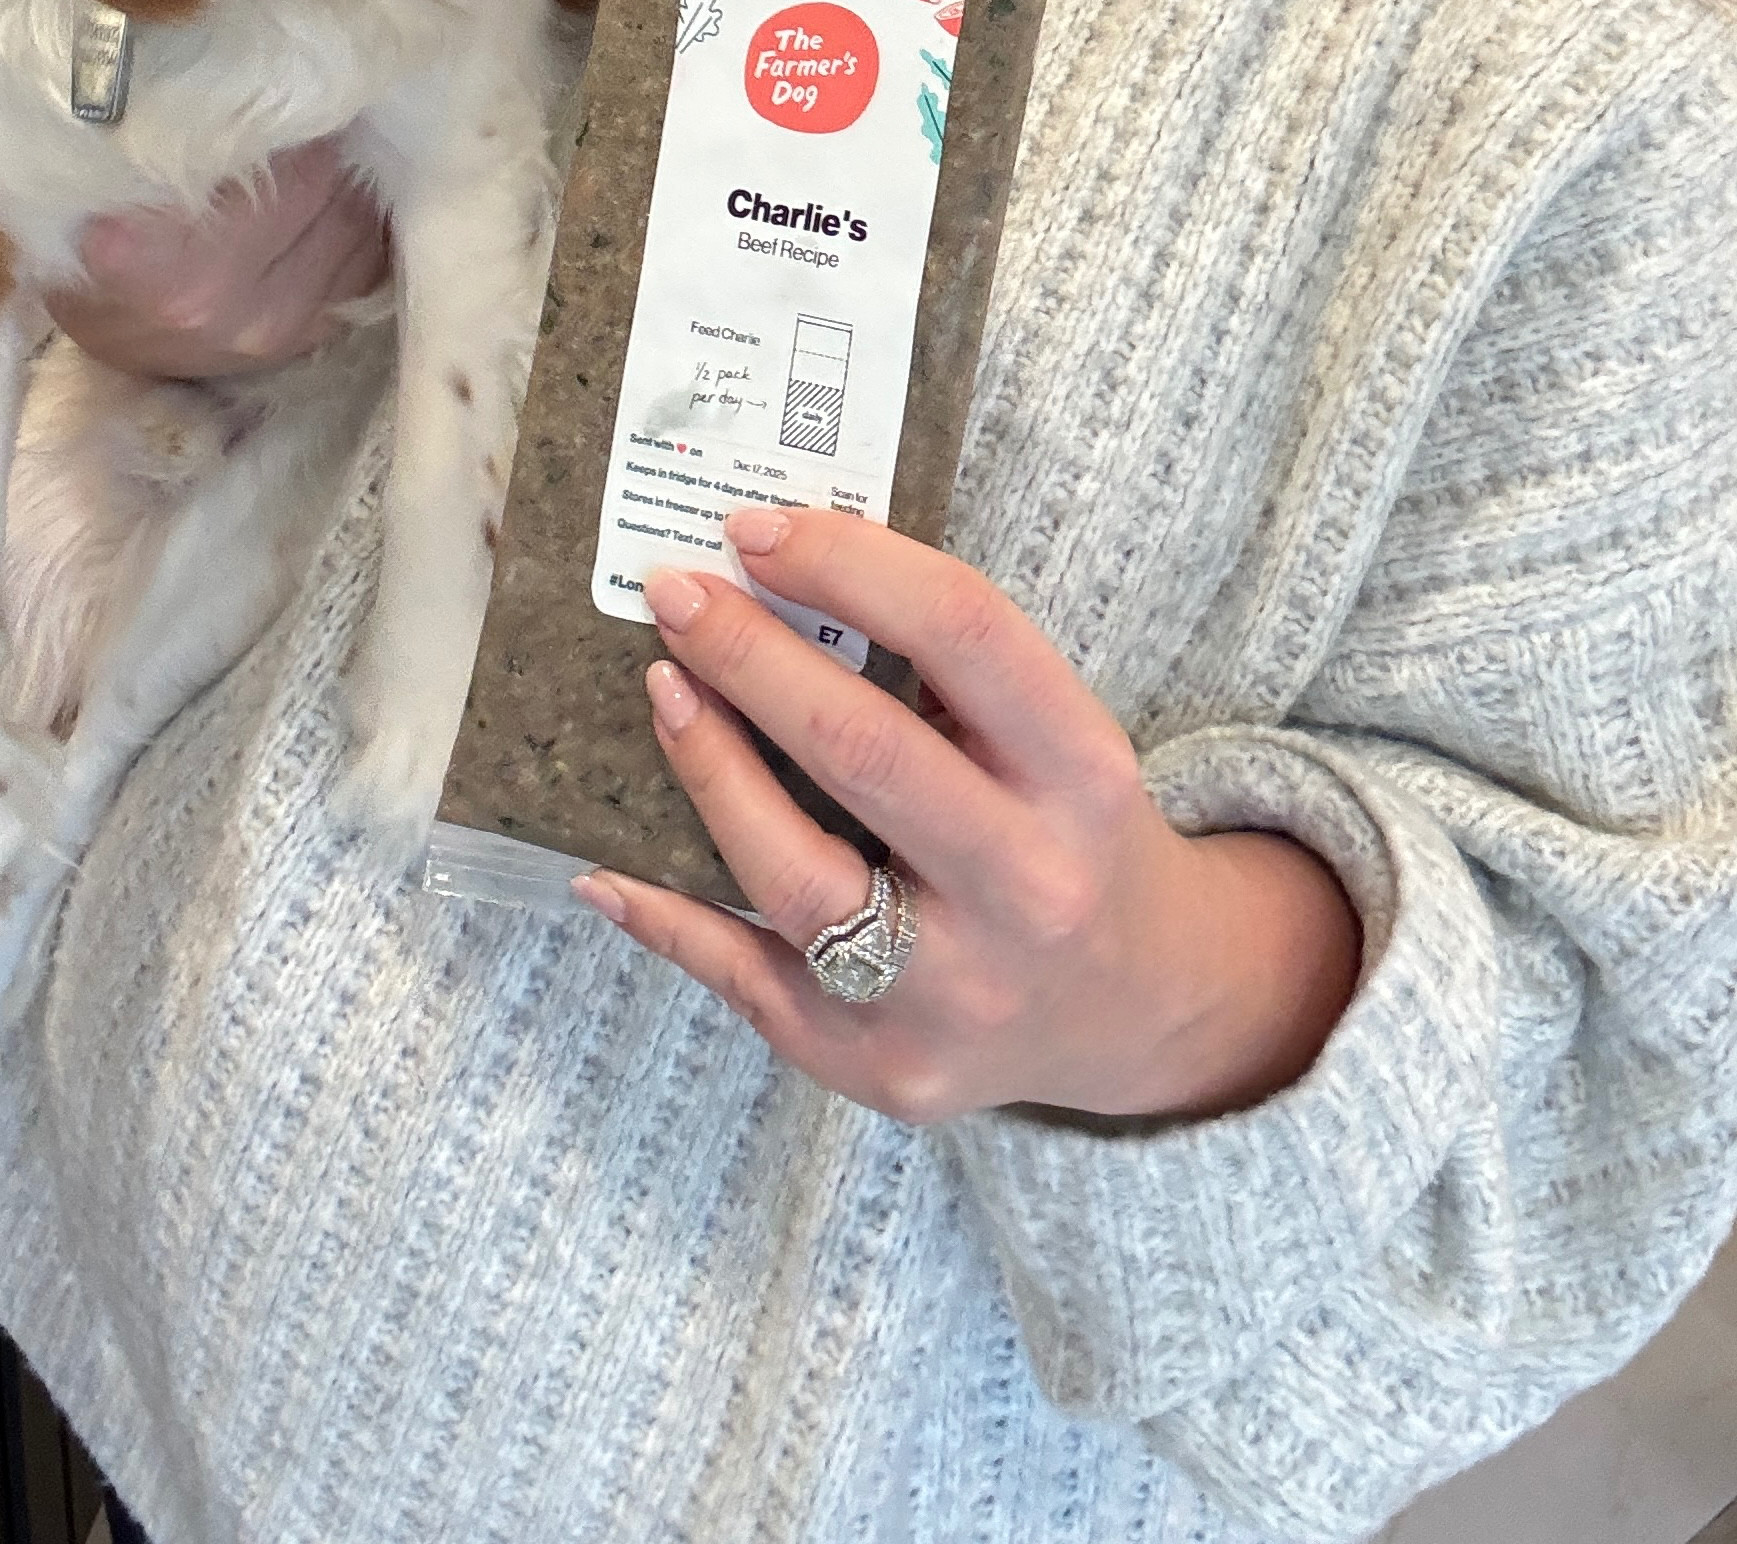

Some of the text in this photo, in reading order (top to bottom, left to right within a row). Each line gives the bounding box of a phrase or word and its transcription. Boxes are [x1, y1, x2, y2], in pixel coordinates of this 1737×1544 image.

[774, 27, 824, 51] The
[753, 50, 858, 79] Farmer's
[771, 80, 818, 113] Dog
[727, 188, 868, 242] Charlie's
[737, 231, 840, 269] Beef Recipe
[690, 320, 761, 346] Feed Charlie
[715, 366, 752, 388] pack
[689, 388, 743, 416] per day
[802, 411, 823, 423] daily
[630, 433, 652, 446] Sent
[654, 439, 674, 451] with
[689, 448, 703, 457] on
[733, 459, 751, 472] Dec
[626, 461, 656, 476] Keeps
[658, 468, 667, 478] in
[668, 470, 697, 486] fridge
[698, 476, 712, 489] for
[713, 482, 721, 490] 4
[721, 483, 744, 496] days
[745, 489, 769, 503] after
[831, 486, 868, 504] Scan for
[622, 489, 653, 505] Stores
[655, 496, 664, 507] in
[666, 498, 700, 515] freezer
[700, 509, 713, 520] up
[714, 511, 724, 522] to
[617, 518, 722, 551] Questions? Text or call
[609, 572, 644, 593] #Lon
[818, 624, 844, 646] E7
